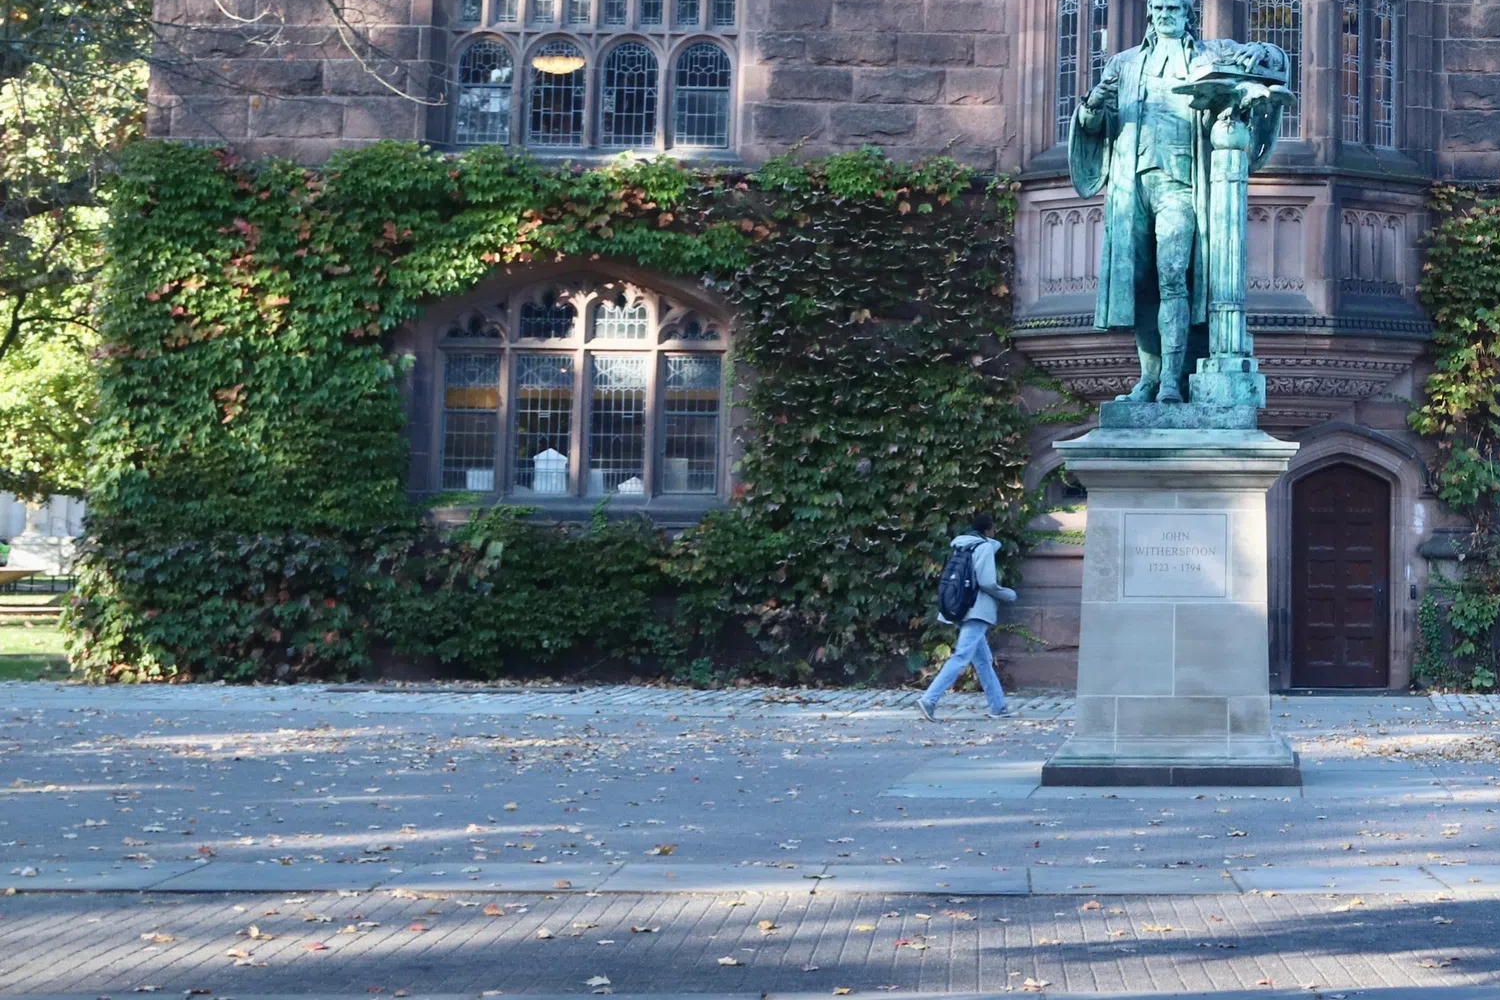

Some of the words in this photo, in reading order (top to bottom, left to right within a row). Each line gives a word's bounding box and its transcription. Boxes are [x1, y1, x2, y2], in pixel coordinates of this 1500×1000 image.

[1161, 531, 1190, 541] JOHN
[1135, 546, 1216, 556] WITHERSPOON
[1148, 563, 1169, 572] 1723
[1181, 563, 1201, 572] 1794
